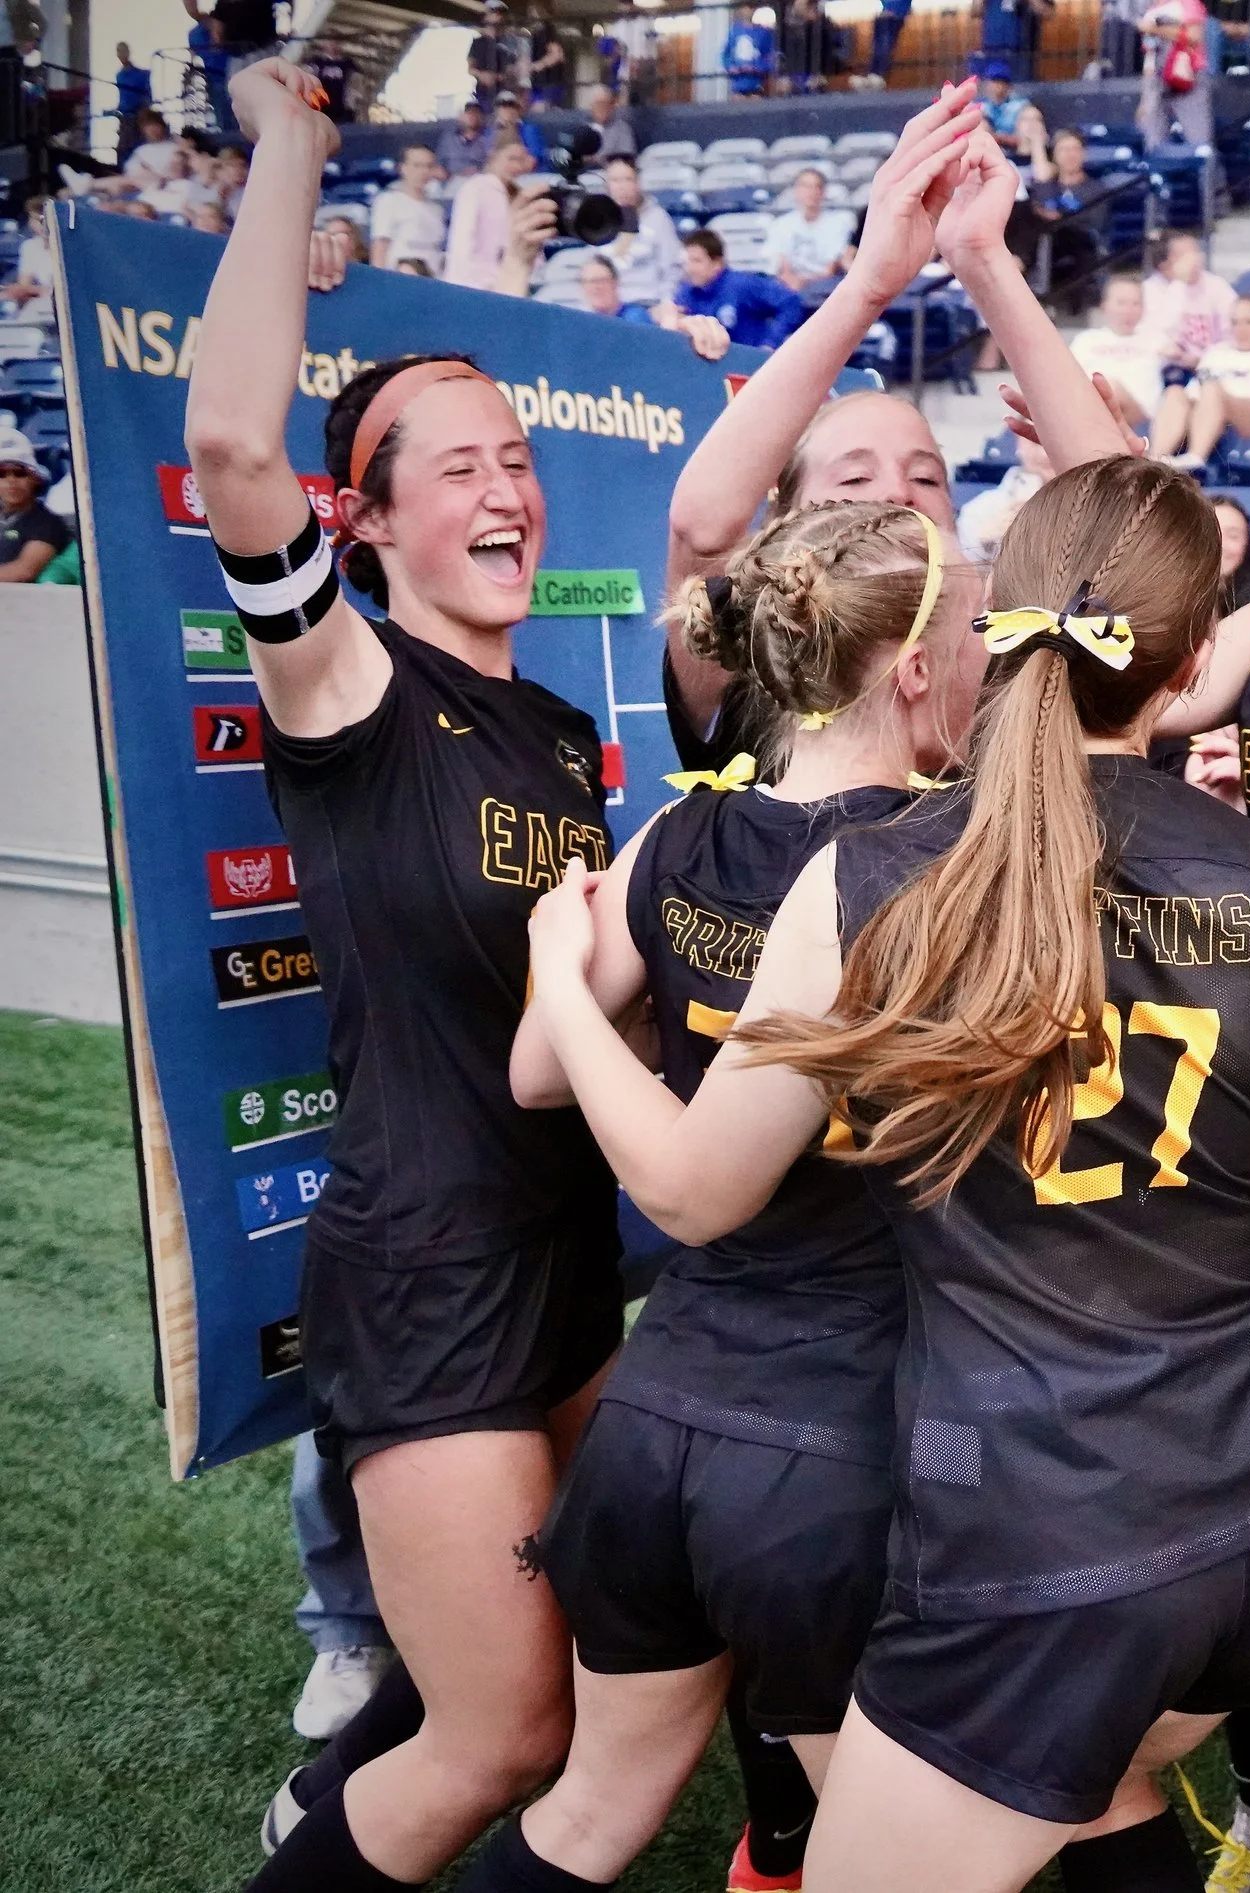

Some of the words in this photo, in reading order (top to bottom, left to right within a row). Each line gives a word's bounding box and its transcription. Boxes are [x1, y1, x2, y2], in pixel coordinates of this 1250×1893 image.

[497, 376, 686, 454] pionships
[550, 580, 634, 606] Catholic
[480, 797, 607, 893] EAST
[260, 949, 319, 983] Gre
[1022, 1001, 1221, 1206] 27
